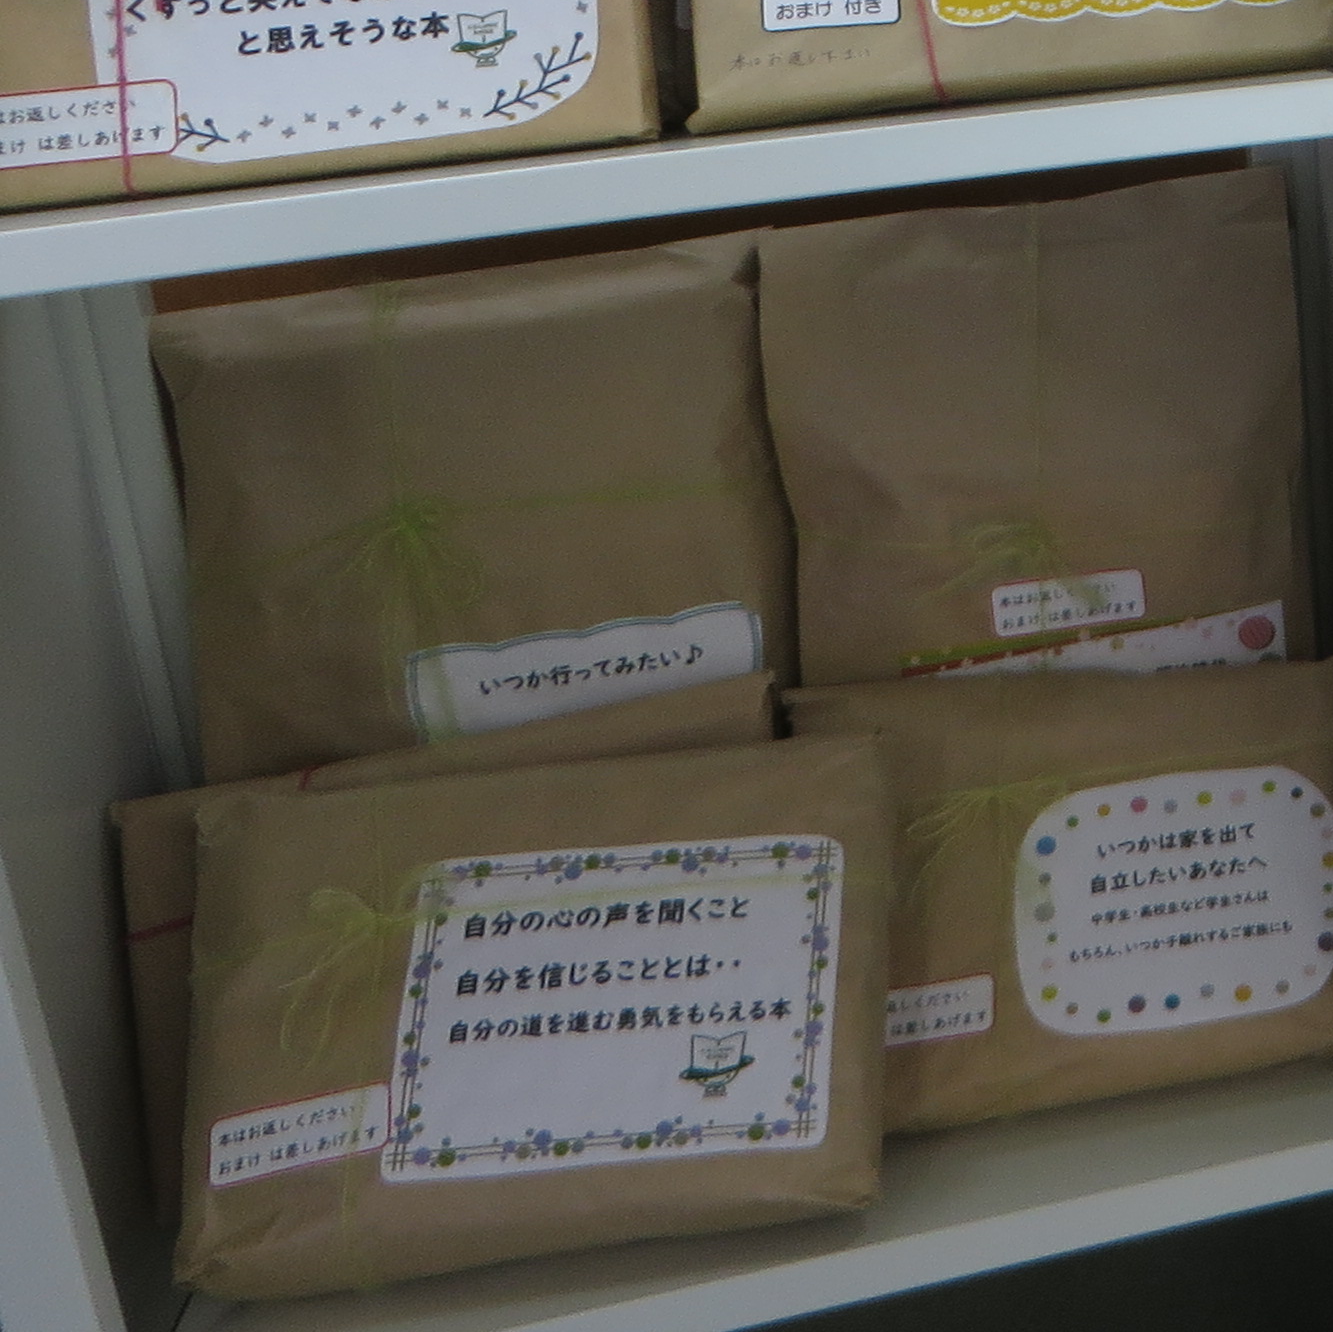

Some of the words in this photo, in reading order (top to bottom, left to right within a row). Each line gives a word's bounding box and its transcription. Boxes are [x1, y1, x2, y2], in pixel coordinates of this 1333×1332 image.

[776, 1, 832, 20] おまけ
[238, 11, 450, 55] と思えそうな本
[1097, 822, 1256, 859] いつかは家を出て
[1091, 855, 1268, 895] 自立したいあなたへ
[463, 894, 750, 940] 自分の心の声を聞くこと
[1069, 918, 1293, 963] もちろん、いつか子離れするご家族にも
[447, 997, 791, 1045] 自分の道を進む勇気をもらえる本
[218, 1105, 356, 1147] 本はお返しください
[218, 1151, 260, 1176] おまけ
